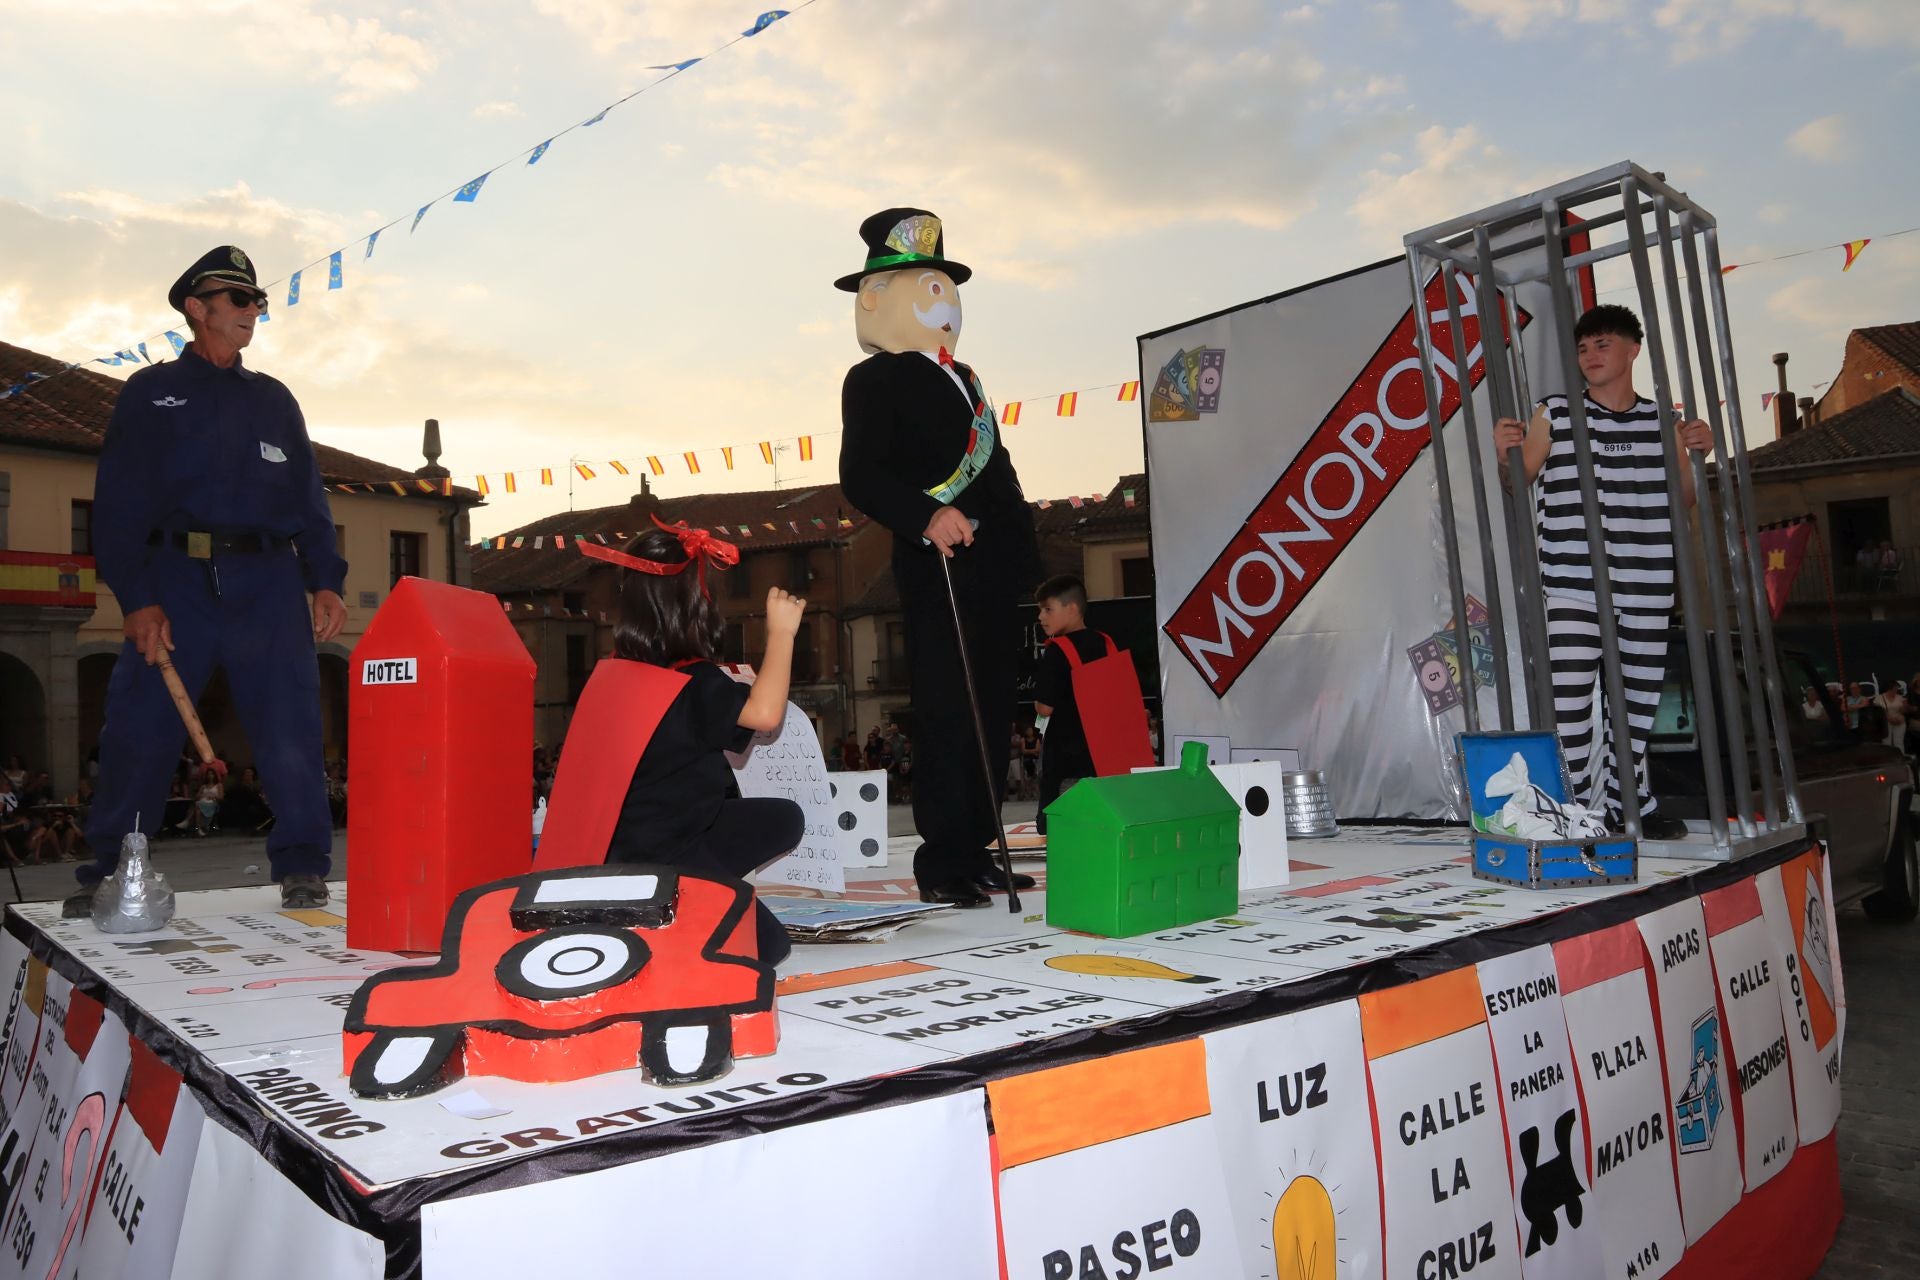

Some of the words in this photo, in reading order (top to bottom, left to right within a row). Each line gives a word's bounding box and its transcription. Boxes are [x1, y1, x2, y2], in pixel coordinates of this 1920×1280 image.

[924, 229, 933, 243] 500
[1205, 377, 1215, 385] 5
[1604, 443, 1633, 452] 69169
[1179, 270, 1490, 683] MONOPOLY
[367, 660, 414, 683] HOTEL
[1428, 671, 1442, 682] 5
[1394, 864, 1465, 878] ARCAS
[1431, 892, 1489, 907] MAYO
[225, 915, 277, 930] CALLE
[1154, 924, 1244, 942] CALL
[1228, 932, 1289, 944] LA
[240, 953, 288, 967] DEL
[300, 944, 367, 964] PLAZA
[967, 942, 1053, 959] LUZ
[1268, 933, 1367, 956] CRUZ
[1661, 927, 1700, 973] ARCAS
[164, 956, 221, 976] TESO
[1729, 959, 1771, 1001] CALLE
[813, 978, 972, 1010] PASEO
[843, 1006, 925, 1025] DE
[931, 986, 1031, 1008] LOS
[1485, 972, 1558, 1017] ESTACIÓN
[1786, 952, 1810, 1043] SOLO
[181, 1023, 221, 1039] 220
[882, 993, 1106, 1042] MORALES
[1050, 1013, 1114, 1029] 180
[10, 1037, 28, 1083] CALLE
[1523, 1030, 1544, 1055] LA
[1591, 1034, 1648, 1081] PLAZA
[1510, 1062, 1565, 1102] PANERA
[1738, 1035, 1787, 1096] MESONES
[236, 1067, 387, 1140] PARKING
[1256, 1062, 1329, 1123] LUZ
[439, 1072, 829, 1159] GRATUITO
[1399, 1081, 1486, 1146] CALLE
[1596, 1112, 1665, 1178] MAYOR
[102, 1149, 145, 1246] CALLE
[1431, 1156, 1471, 1204] LA
[11, 1202, 36, 1271] TESO
[1042, 1207, 1201, 1280] PASEO
[1416, 1220, 1497, 1280] CRUZ
